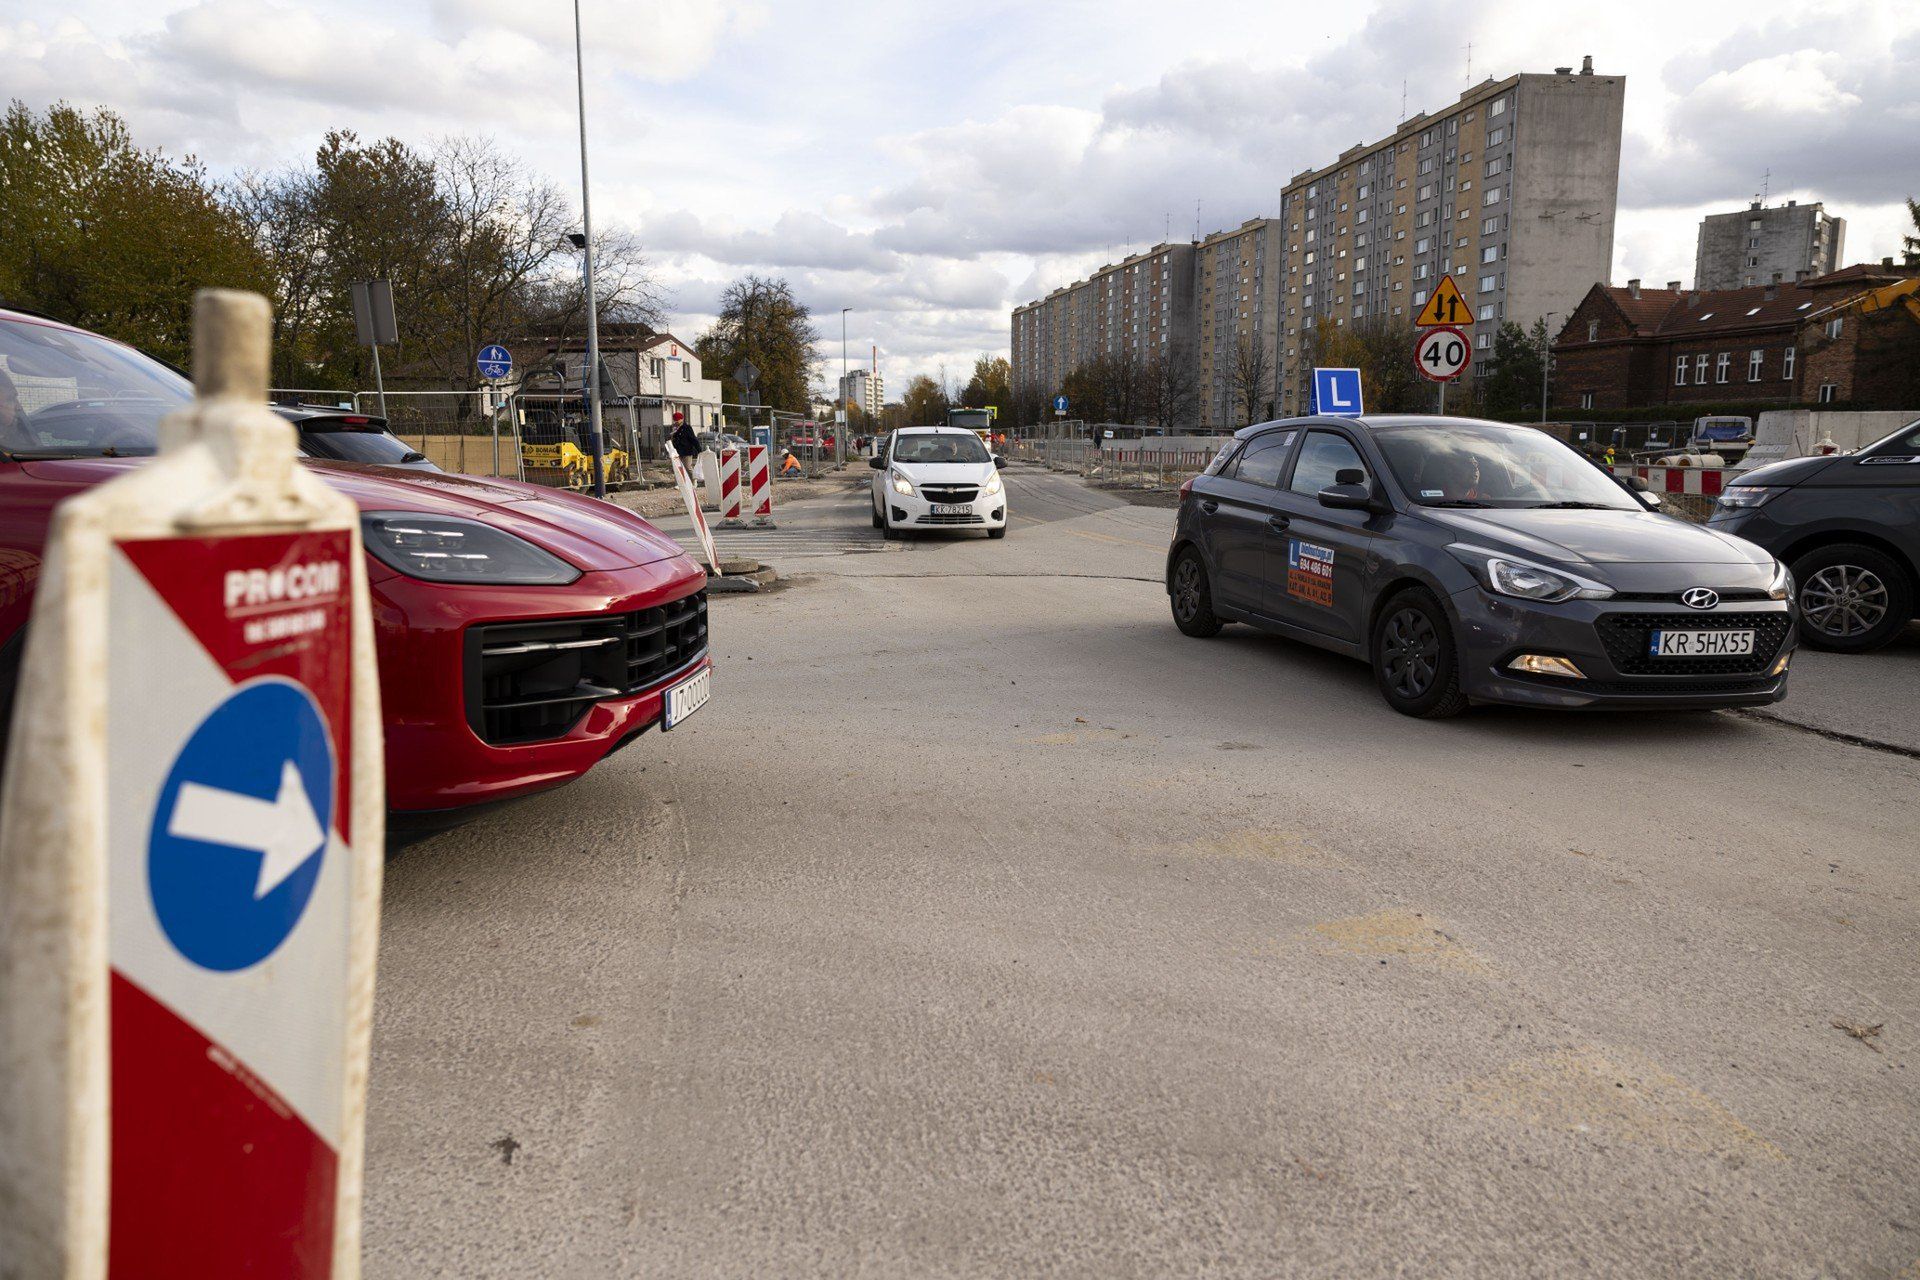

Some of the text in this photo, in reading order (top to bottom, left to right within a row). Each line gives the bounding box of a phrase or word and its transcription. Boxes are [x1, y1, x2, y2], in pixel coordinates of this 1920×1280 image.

[1422, 340, 1464, 367] 40
[1330, 376, 1351, 407] L
[1662, 632, 1750, 654] KR 5HX55
